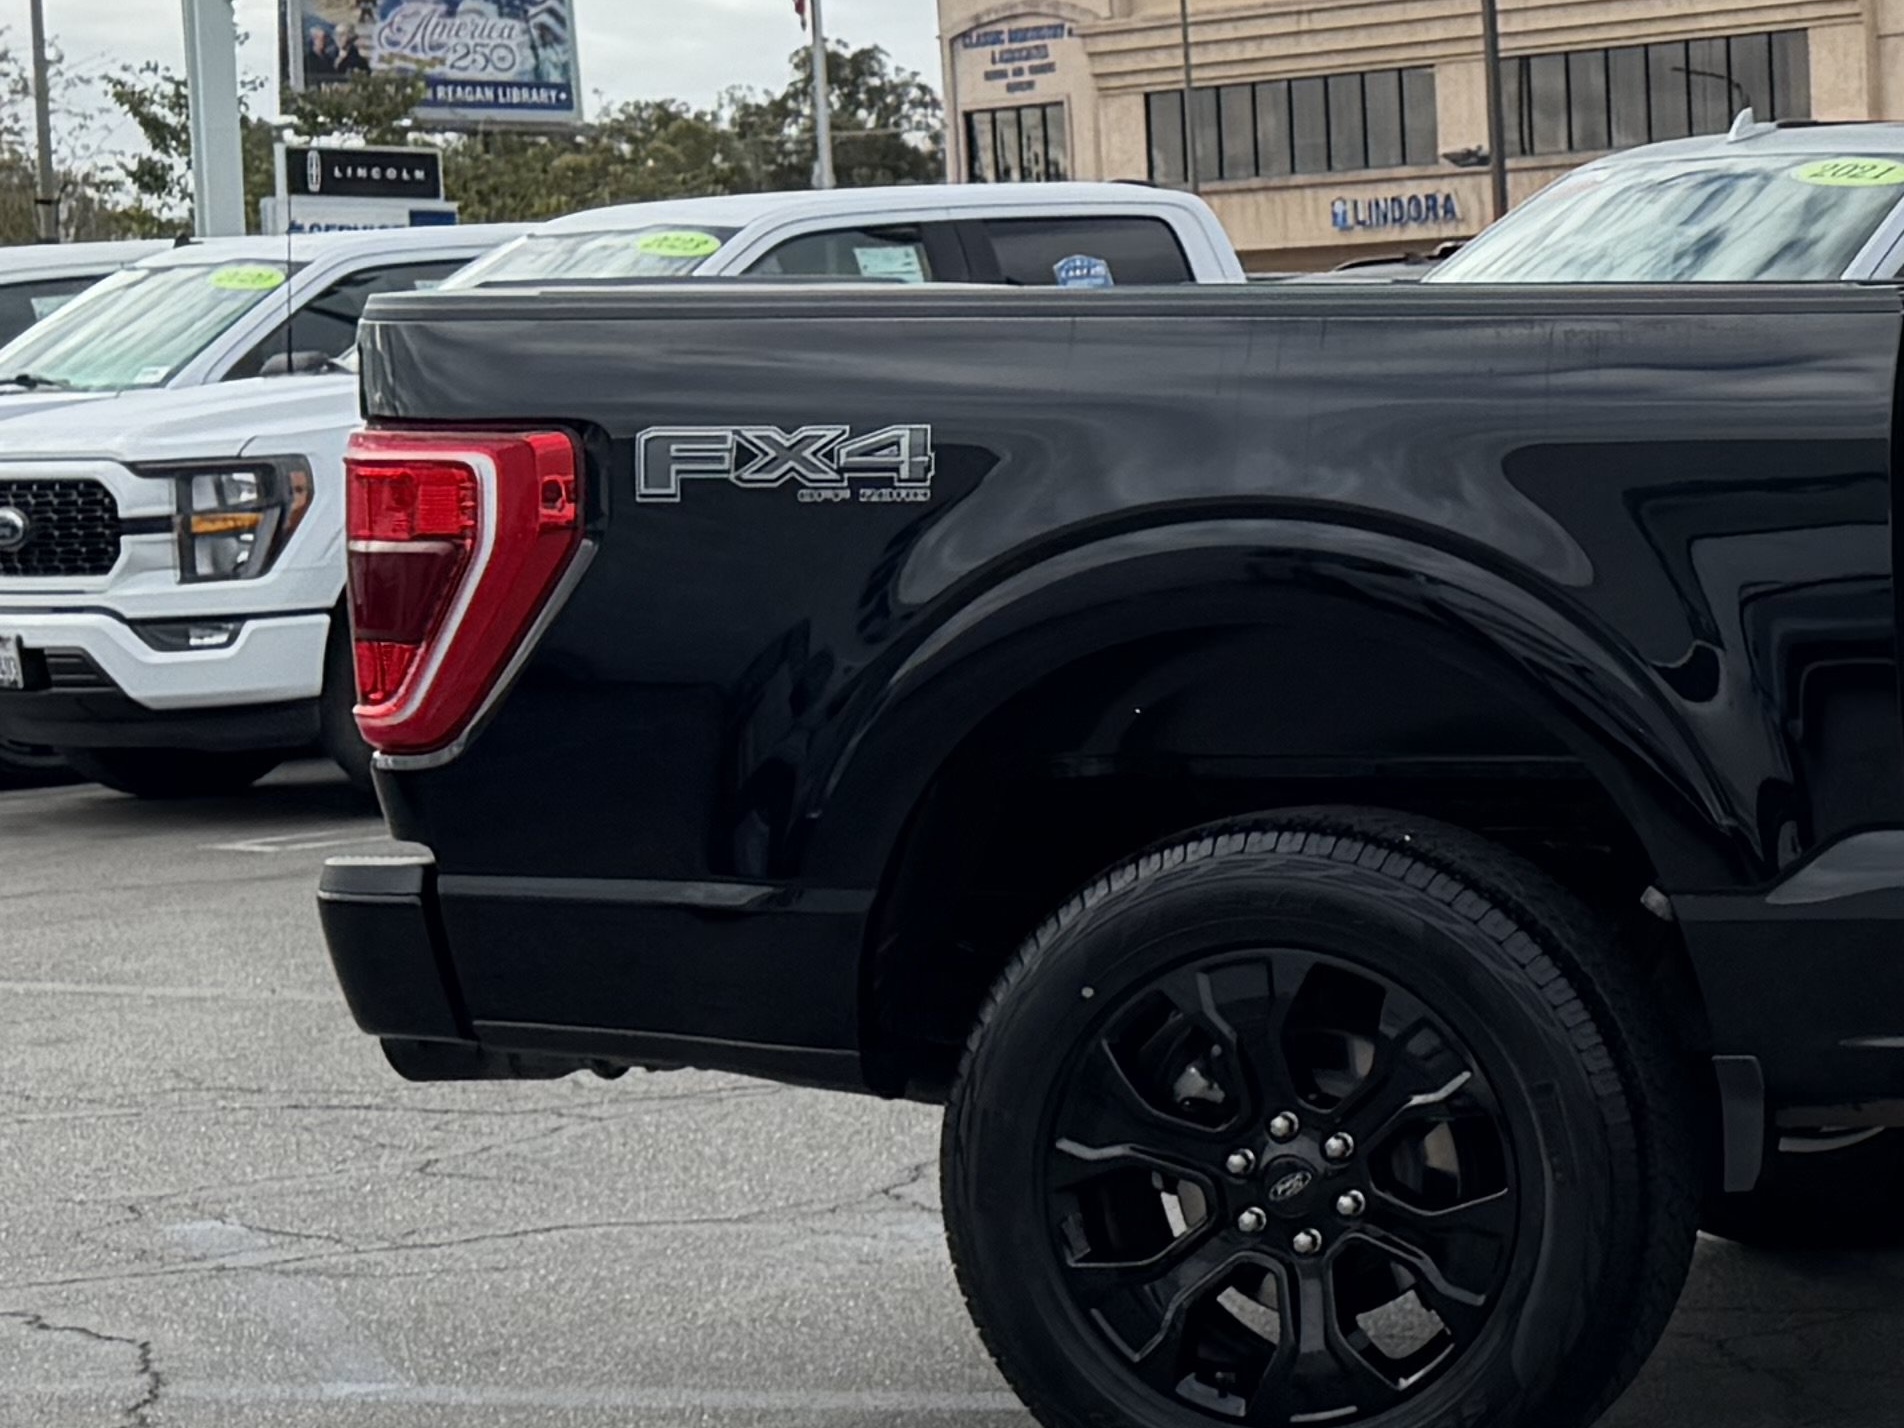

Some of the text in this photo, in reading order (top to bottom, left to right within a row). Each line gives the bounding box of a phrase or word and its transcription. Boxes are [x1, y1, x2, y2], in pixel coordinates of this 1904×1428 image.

[378, 8, 520, 55] America
[450, 42, 517, 72] 250
[436, 85, 494, 102] REAGAN
[498, 88, 558, 105] LIBRARY
[333, 165, 425, 181] LINCOLN
[1808, 162, 1897, 180] 2021
[1353, 193, 1457, 227] LINDORA
[635, 424, 936, 503] FX4
